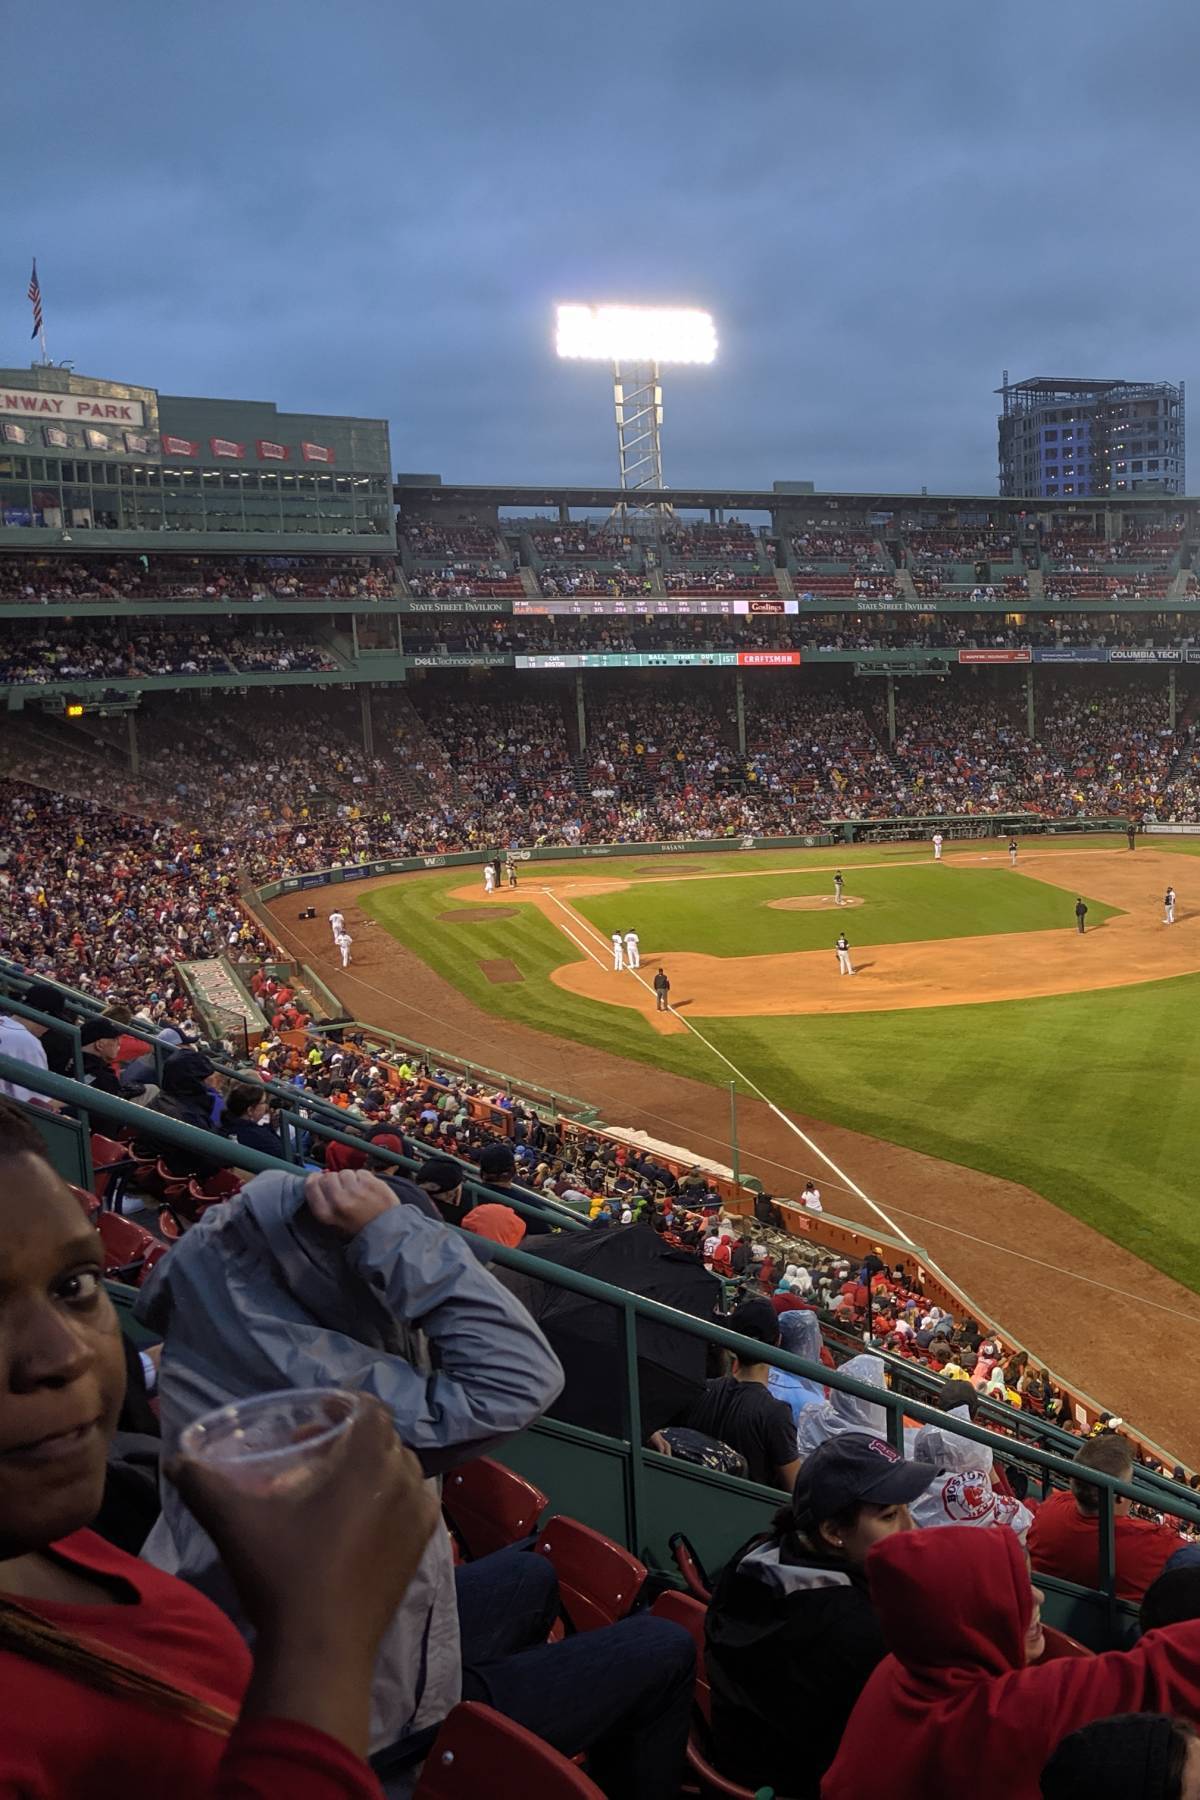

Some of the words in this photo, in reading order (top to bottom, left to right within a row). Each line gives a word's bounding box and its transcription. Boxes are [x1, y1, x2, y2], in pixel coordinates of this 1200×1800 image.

[0, 395, 63, 413] NWAY
[77, 402, 132, 420] PARK
[410, 603, 433, 611] STATE
[434, 603, 462, 611] STREET
[465, 603, 502, 611] PAVILION
[857, 602, 877, 610] STATE
[879, 602, 903, 610] STREET
[905, 602, 936, 610] PAVILION
[744, 655, 792, 663] CRAFTSMAN
[1111, 651, 1155, 659] COLUMBIA
[415, 657, 437, 665] DELL
[438, 656, 484, 666] Technologies
[486, 656, 504, 665] Level
[868, 1439, 902, 1464] B
